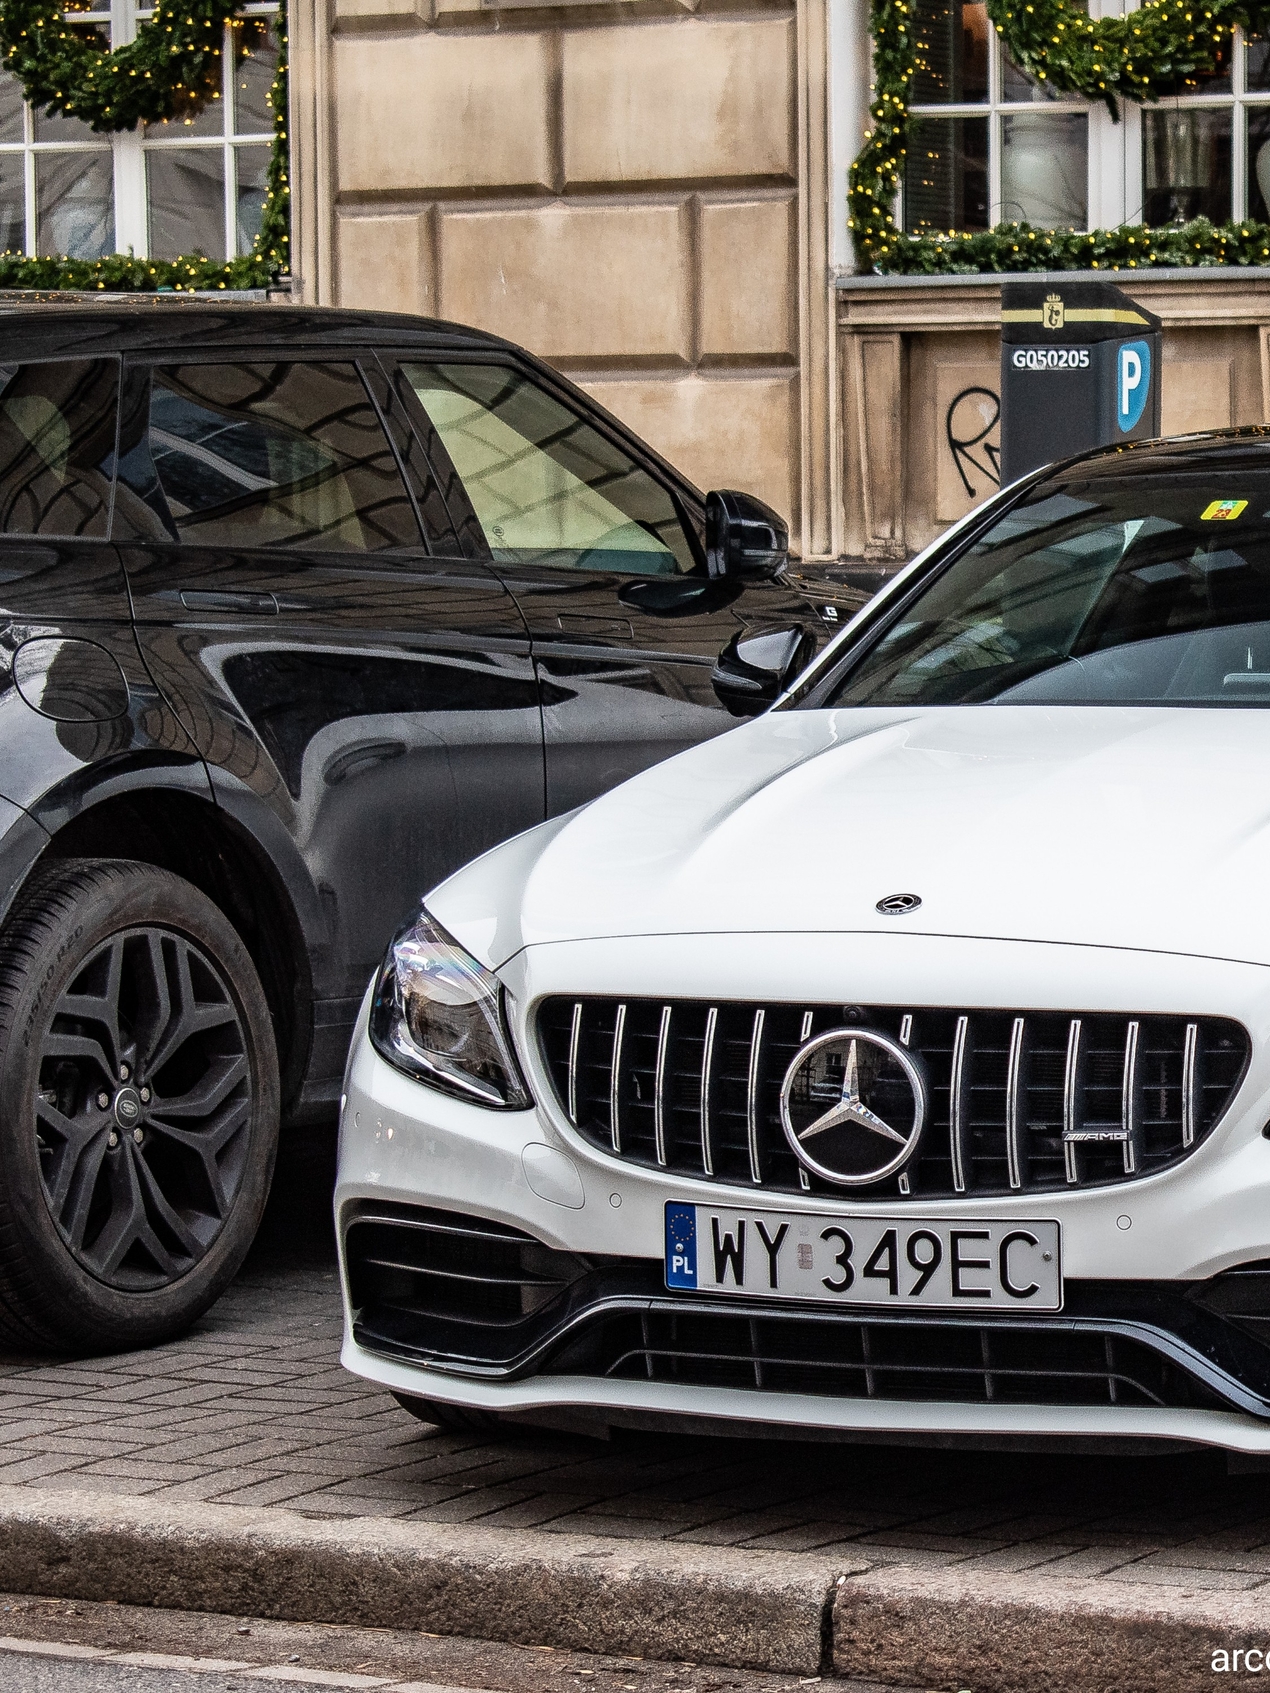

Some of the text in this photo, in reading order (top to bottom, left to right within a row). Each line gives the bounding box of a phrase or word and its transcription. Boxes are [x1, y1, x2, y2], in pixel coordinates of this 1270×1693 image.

[1013, 350, 1090, 368] G050205
[1122, 350, 1142, 415] P
[672, 1255, 694, 1275] PL
[711, 1216, 1041, 1299] WY 349EC
